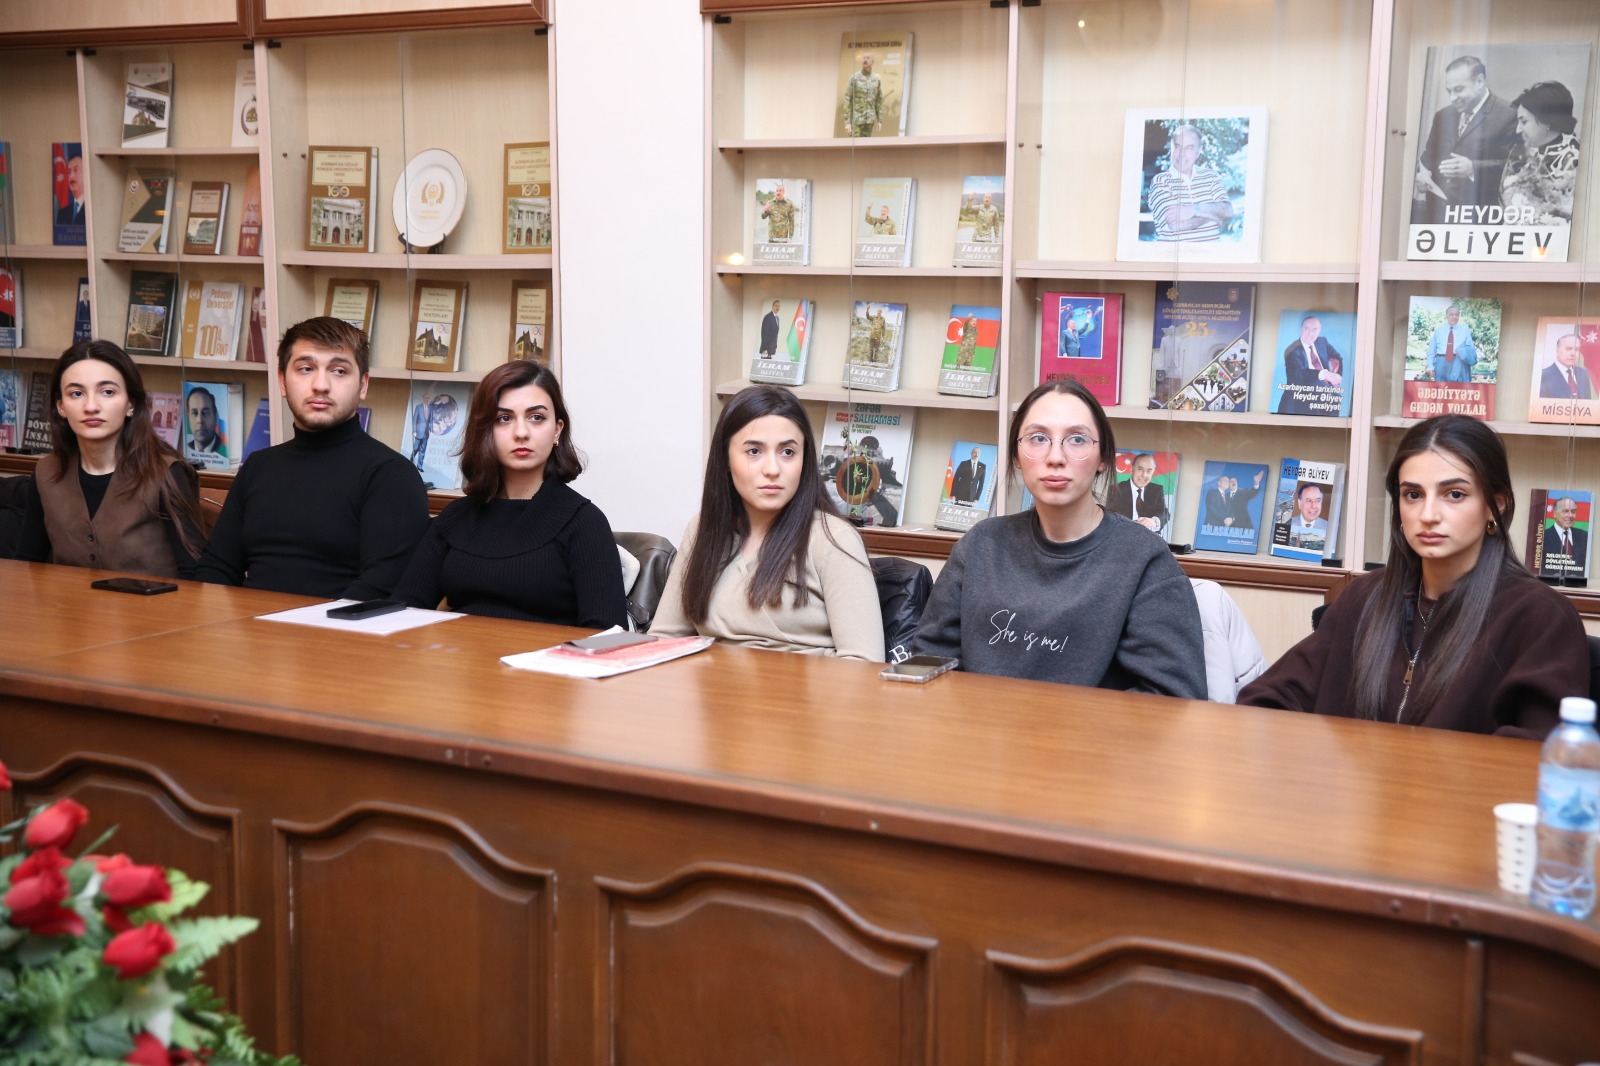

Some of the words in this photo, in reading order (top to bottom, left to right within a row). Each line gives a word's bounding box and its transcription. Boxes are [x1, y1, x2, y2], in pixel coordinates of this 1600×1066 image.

[1444, 204, 1536, 225] HEYDƏR
[760, 244, 796, 254] İLHAM
[1416, 229, 1553, 257] ƏLİYEV
[1185, 321, 1209, 337] 25
[757, 360, 792, 371] İLHAM
[850, 367, 886, 378] İLHAM
[944, 372, 982, 382] İLHAM
[1278, 383, 1315, 392] Azərbaycan
[1315, 385, 1344, 393] tarixində
[1293, 392, 1319, 402] Heydər
[1320, 393, 1343, 403] Əliyev
[855, 403, 881, 414] ZƏFƏR
[1309, 402, 1342, 412] şəxsiyyəti
[1410, 402, 1444, 414] GEDƏN
[1447, 403, 1487, 415] YOLLAR
[1542, 403, 1592, 417] MİSSİYA
[853, 413, 901, 426] SALNAMƏSİ
[1284, 465, 1306, 477] HEYDƏR
[1308, 467, 1330, 480] ƏLİYEV
[989, 609, 1018, 645] She
[1023, 631, 1039, 651] is
[1040, 635, 1069, 653] me!
